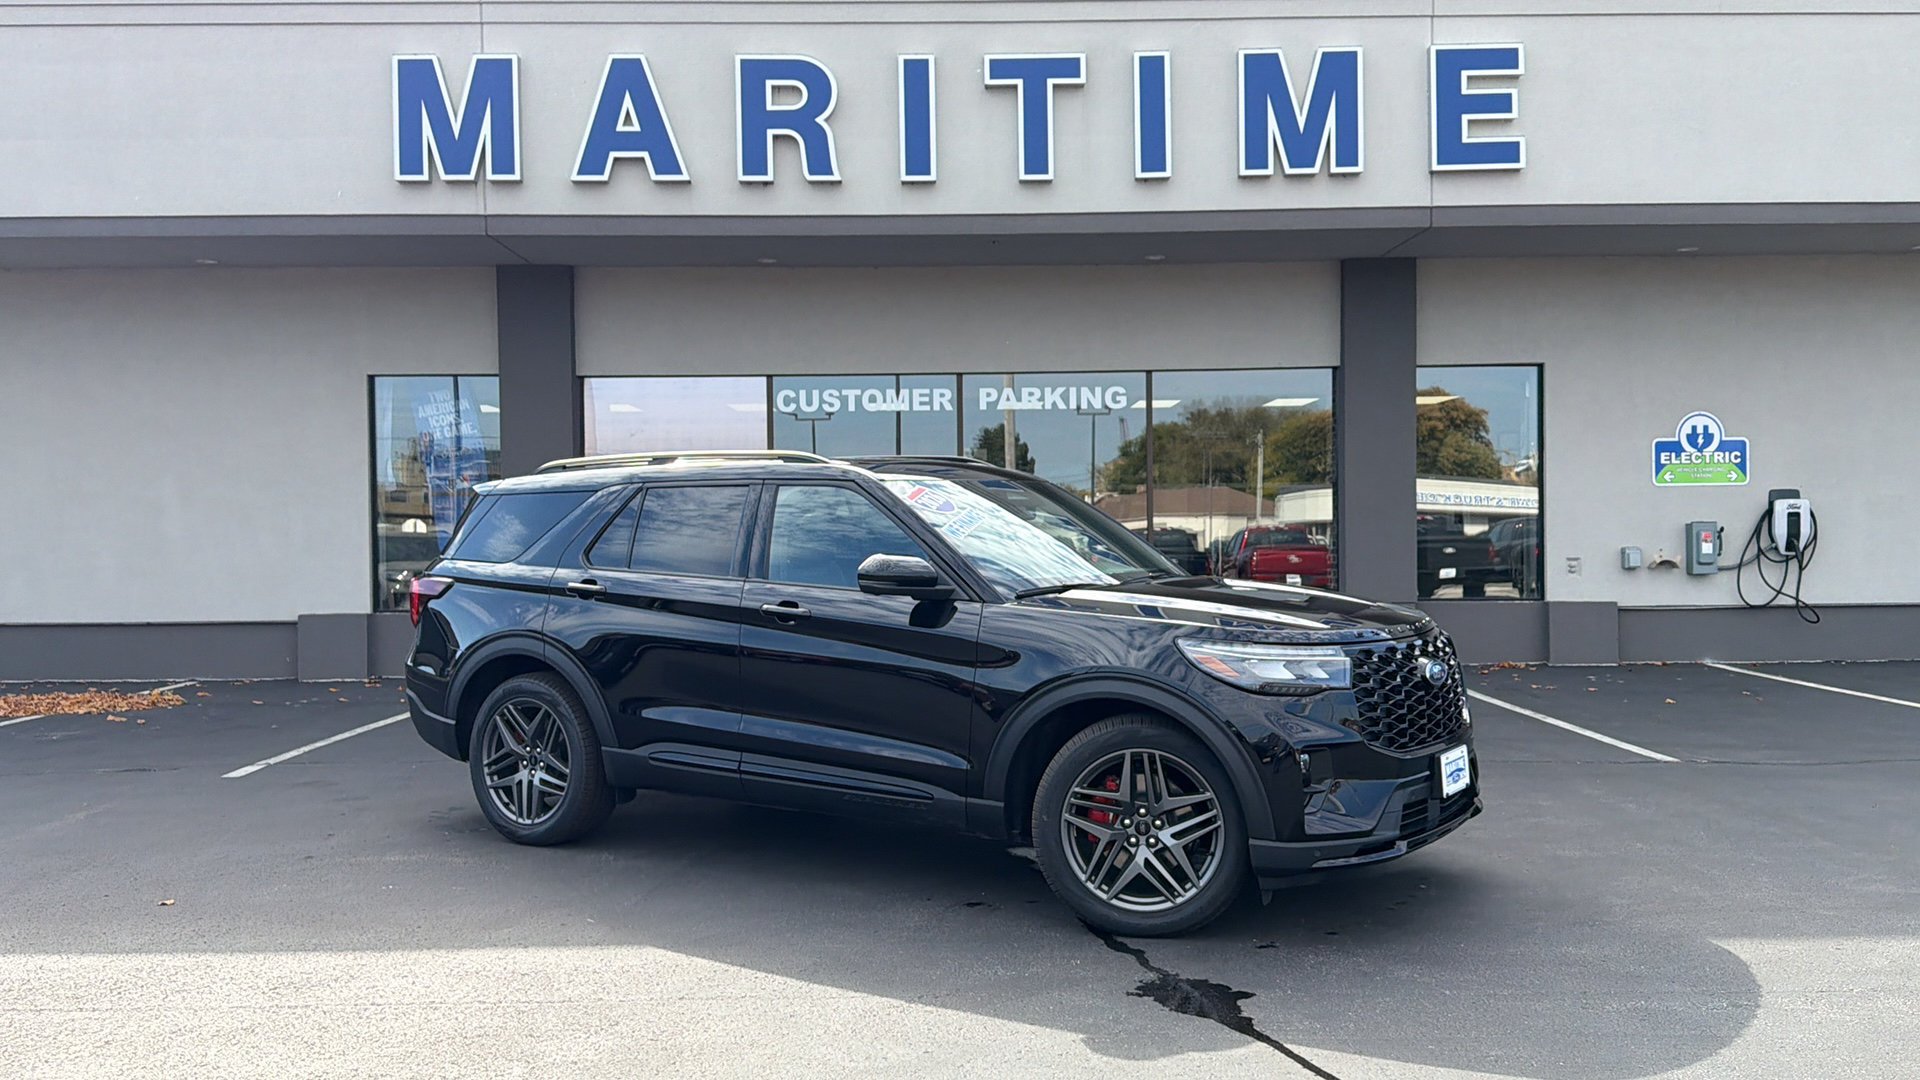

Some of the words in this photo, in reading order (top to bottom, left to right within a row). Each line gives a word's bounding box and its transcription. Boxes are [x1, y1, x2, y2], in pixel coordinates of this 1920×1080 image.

[392, 44, 1527, 184] MARITIME
[776, 388, 954, 413] CUSTOMER
[978, 386, 1128, 411] PARKING
[1660, 451, 1742, 464] ELECTRIC
